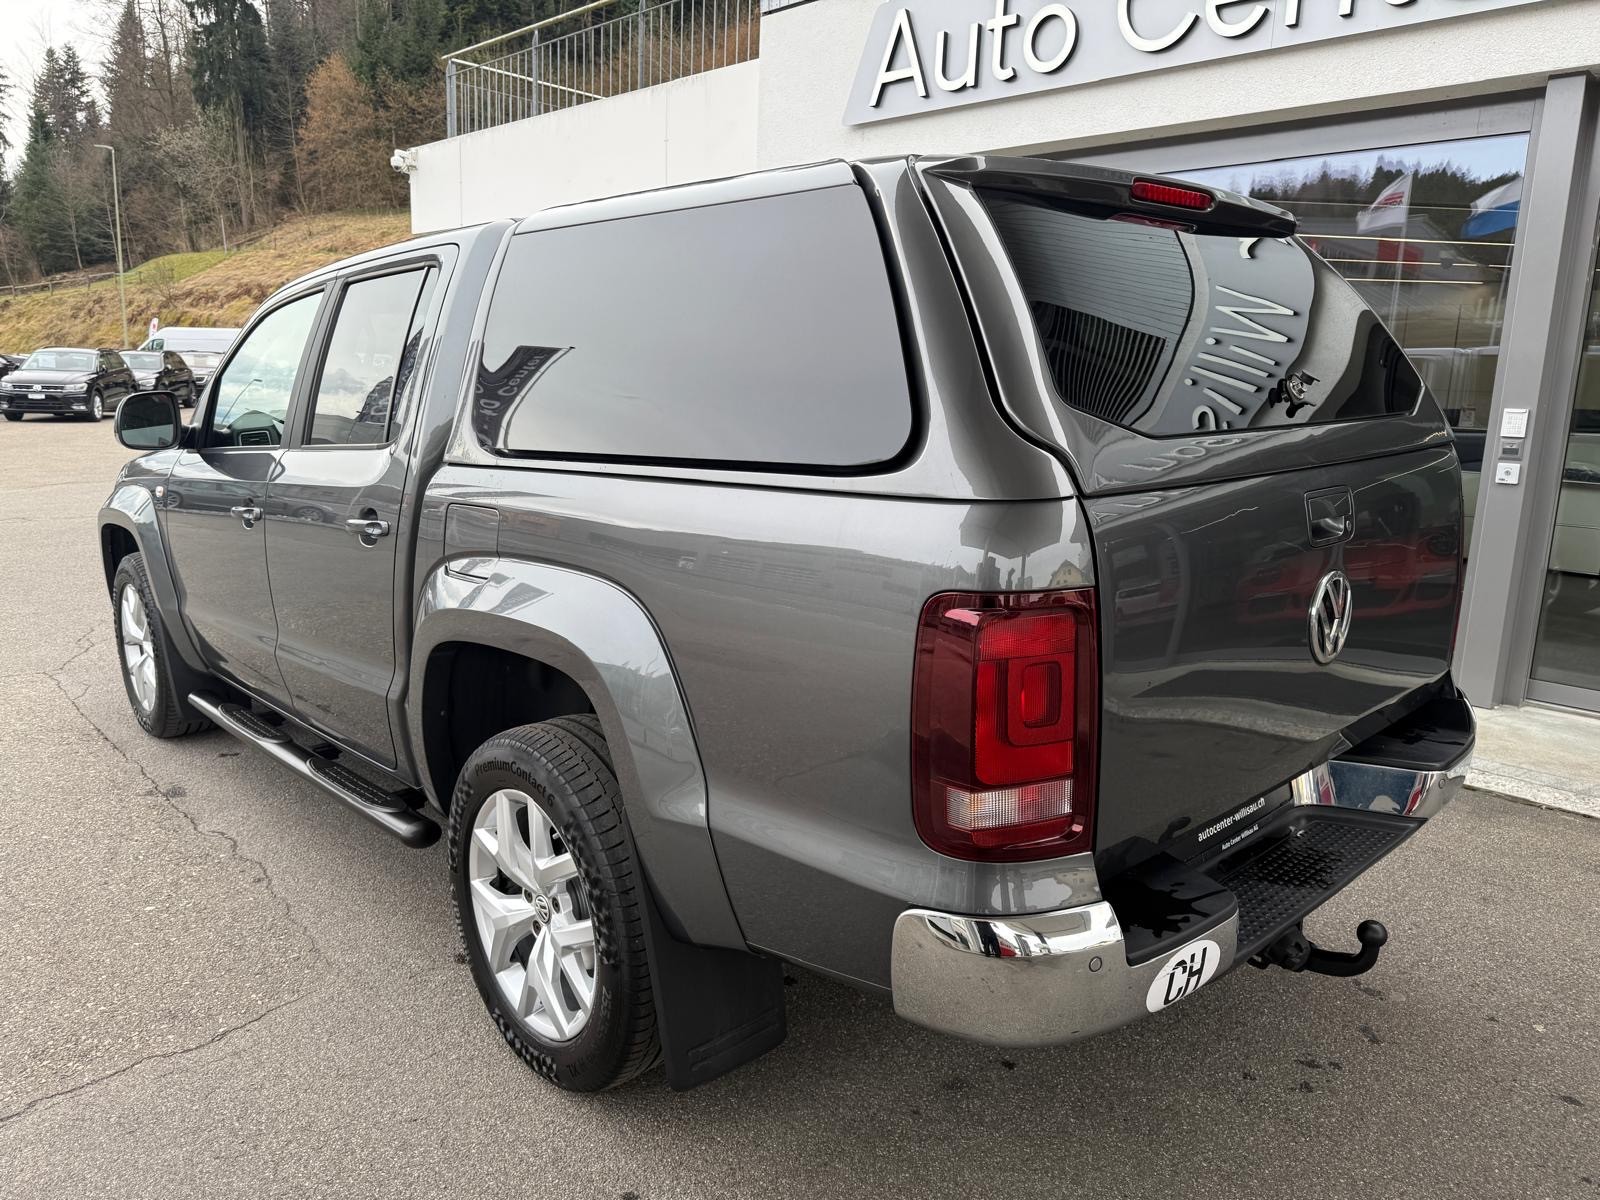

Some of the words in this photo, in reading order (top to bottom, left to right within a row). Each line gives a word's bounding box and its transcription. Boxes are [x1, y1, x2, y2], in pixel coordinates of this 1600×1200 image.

[869, 3, 1079, 107] Auto
[474, 757, 547, 798] PremiumContact
[1198, 797, 1265, 842] autocenter-willisau.ch
[1163, 946, 1208, 1006] CH
